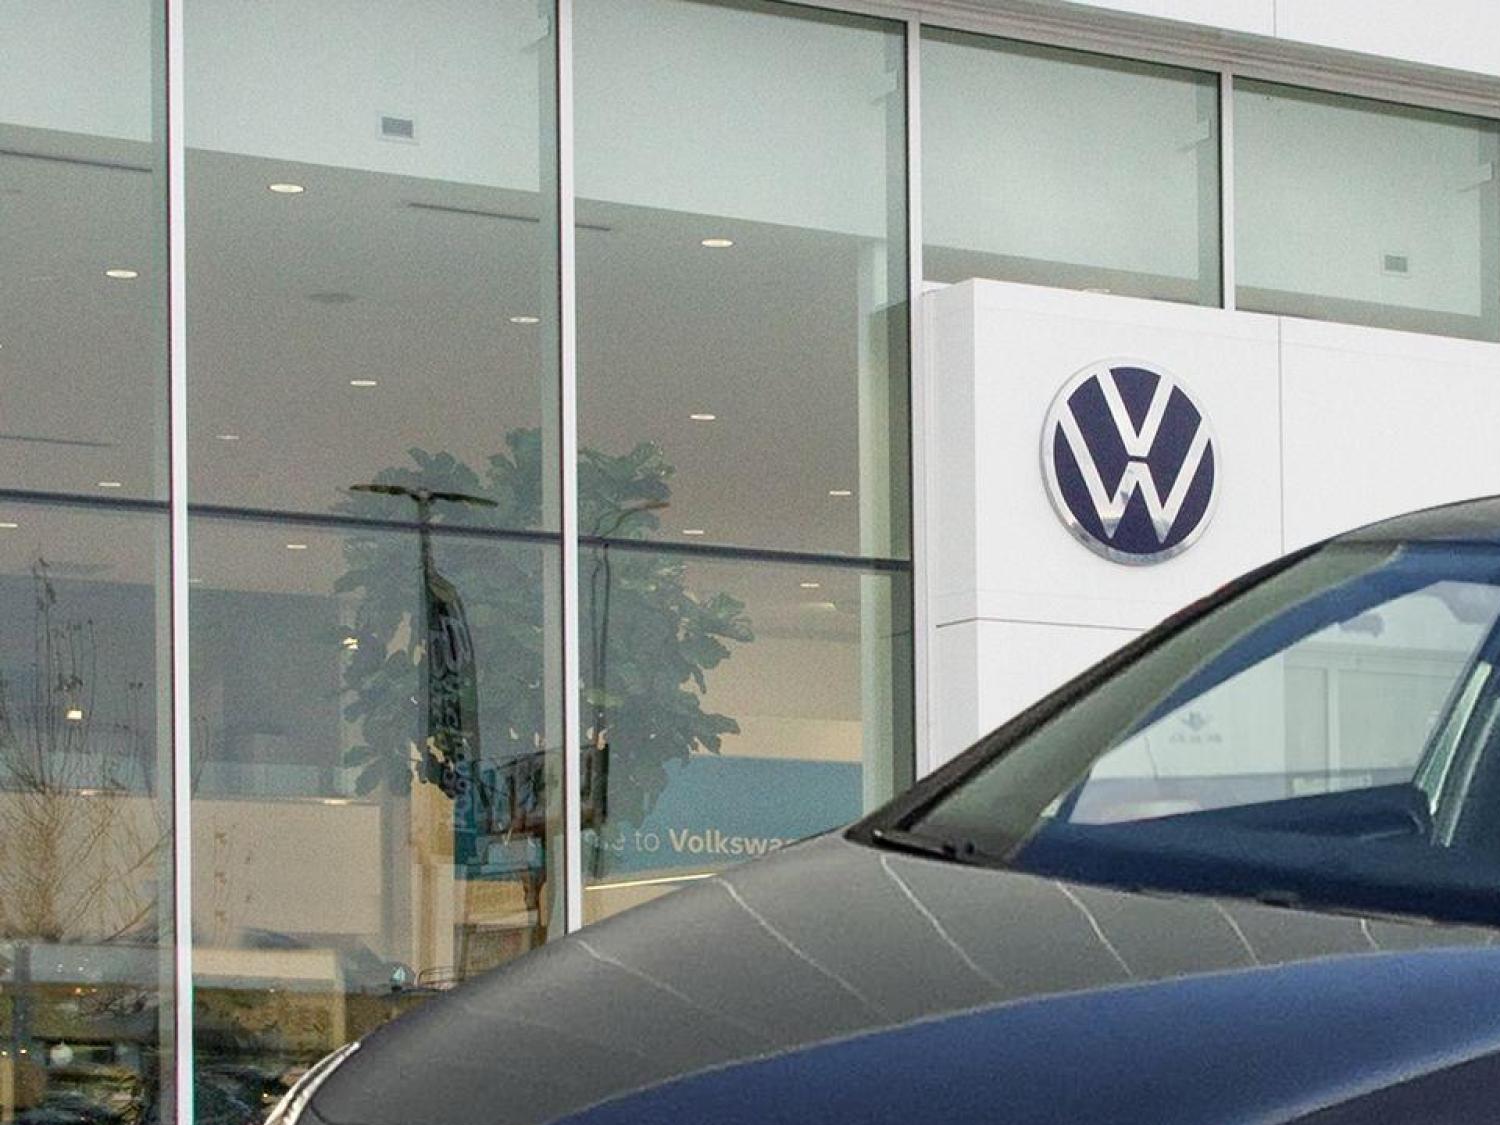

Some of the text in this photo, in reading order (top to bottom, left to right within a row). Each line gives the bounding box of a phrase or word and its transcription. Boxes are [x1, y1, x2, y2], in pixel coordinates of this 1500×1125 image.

[1054, 364, 1213, 543] VW
[634, 831, 662, 852] to
[669, 828, 797, 855] Volkswa
